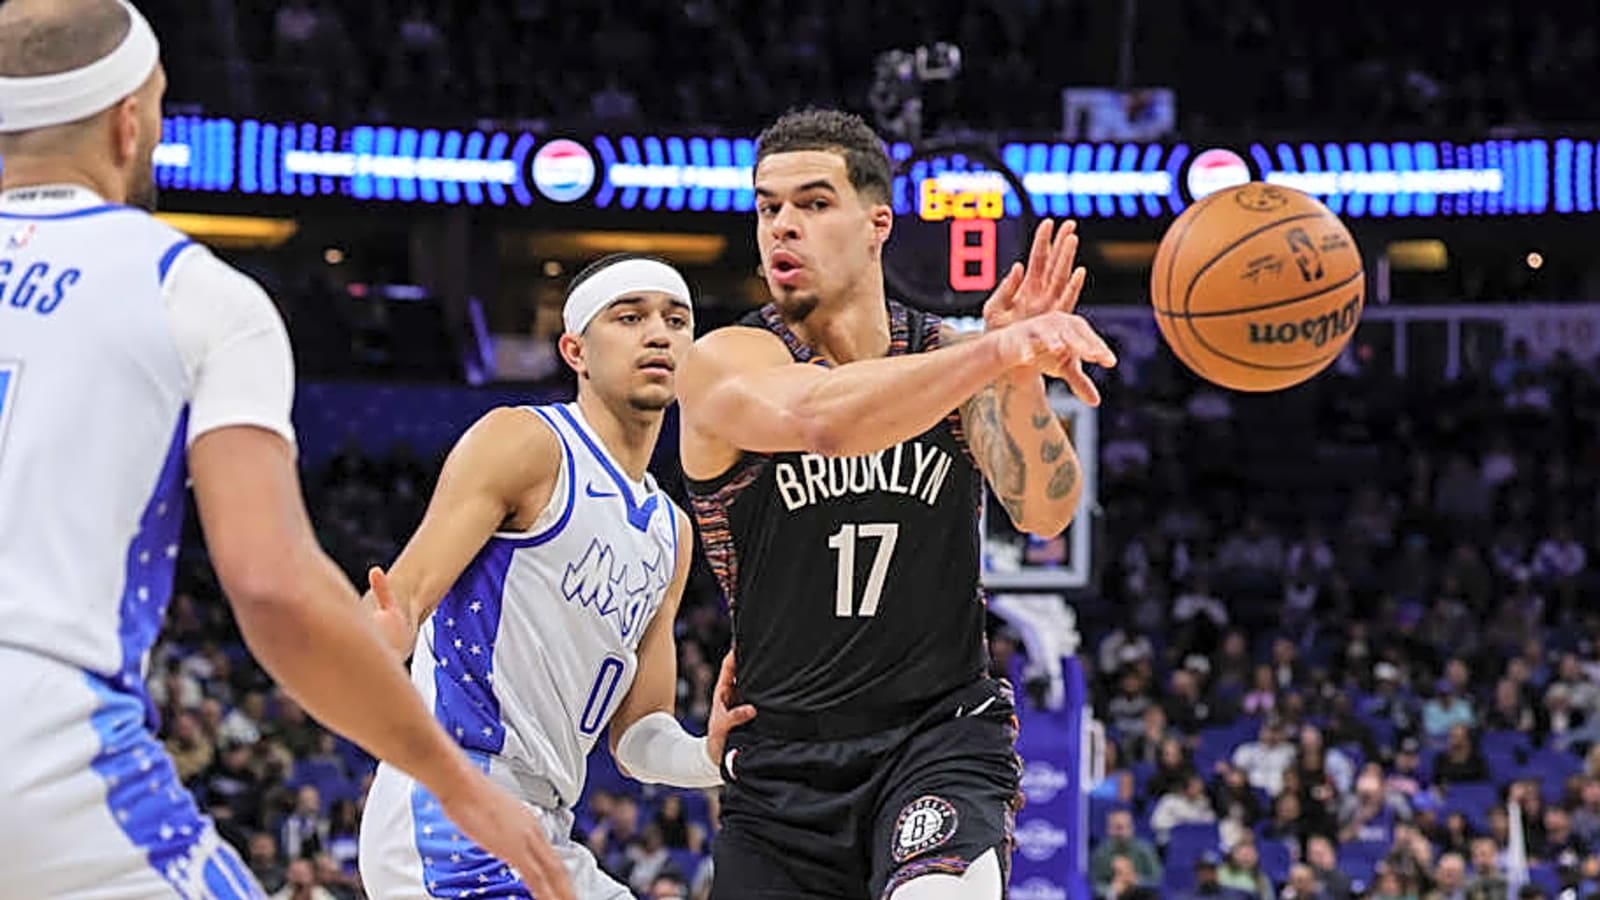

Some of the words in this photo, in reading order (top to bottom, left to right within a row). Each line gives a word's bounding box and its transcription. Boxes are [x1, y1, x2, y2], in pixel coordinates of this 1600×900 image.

[950, 219, 997, 291] 8
[776, 442, 952, 511] BROOKLYN
[829, 523, 899, 617] 17
[579, 657, 624, 735] 0
[911, 814, 927, 842] B
